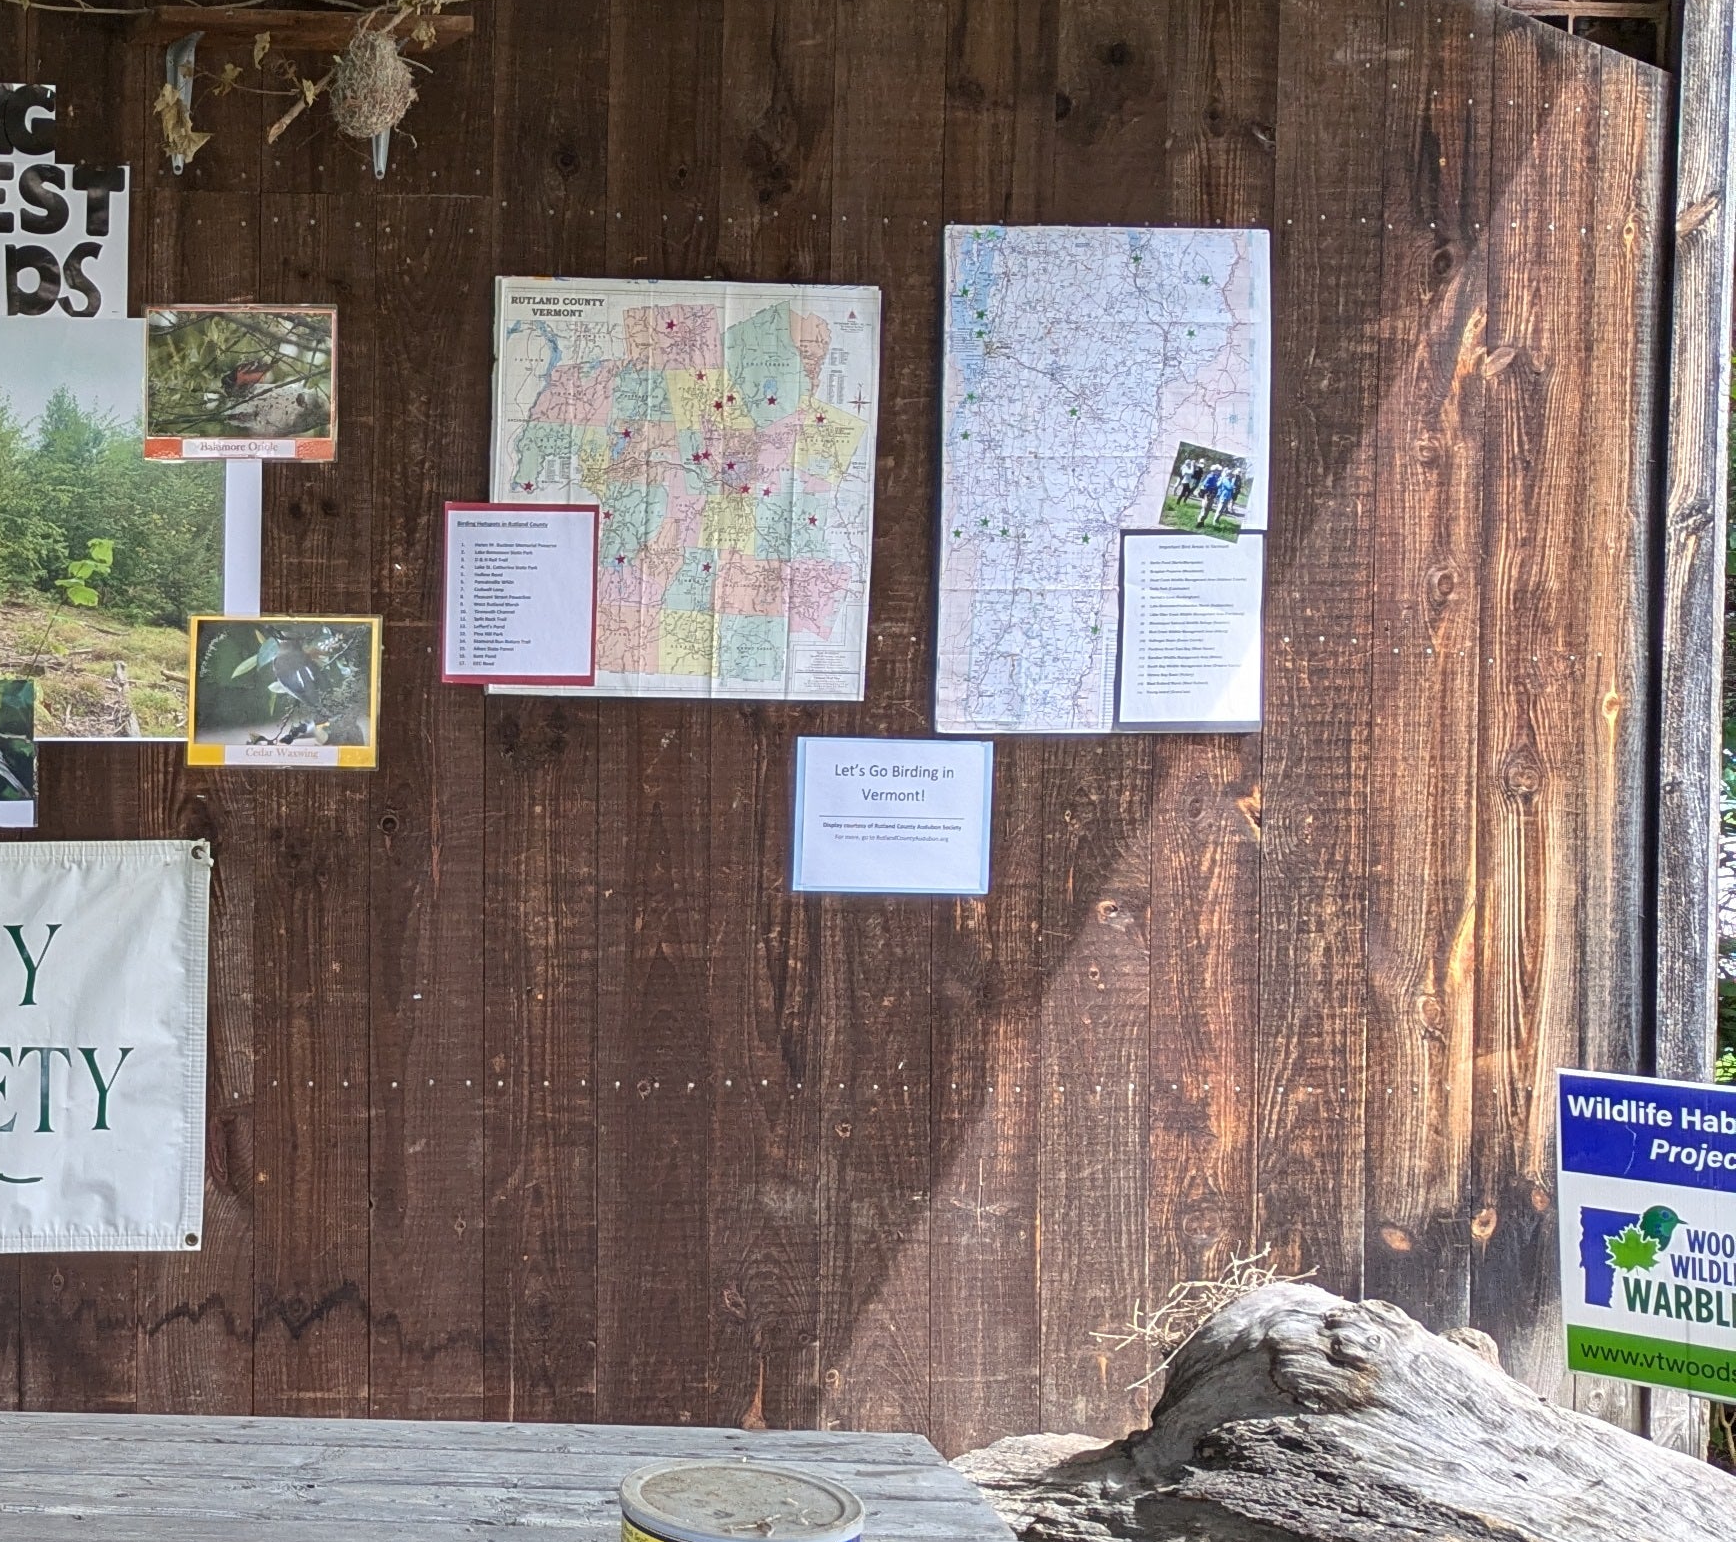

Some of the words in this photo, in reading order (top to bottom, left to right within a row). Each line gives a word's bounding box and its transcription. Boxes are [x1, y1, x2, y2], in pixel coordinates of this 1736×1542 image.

[511, 296, 559, 305] RUTLAND
[562, 297, 604, 306] COUNTY
[532, 308, 583, 317] VERMONT
[200, 441, 245, 451] Baltimore
[248, 441, 278, 452] Oriole
[246, 747, 272, 757] Cedar
[276, 747, 318, 759] Waxwing
[869, 765, 888, 778] Go
[892, 765, 938, 781] Birding
[942, 766, 954, 778] in
[861, 789, 925, 802] Vermont!
[897, 823, 915, 831] County
[1566, 1094, 1673, 1127] Wildlife
[1681, 1107, 1736, 1135] Hab
[1649, 1138, 1736, 1172] Projec
[1686, 1228, 1735, 1259] WOO
